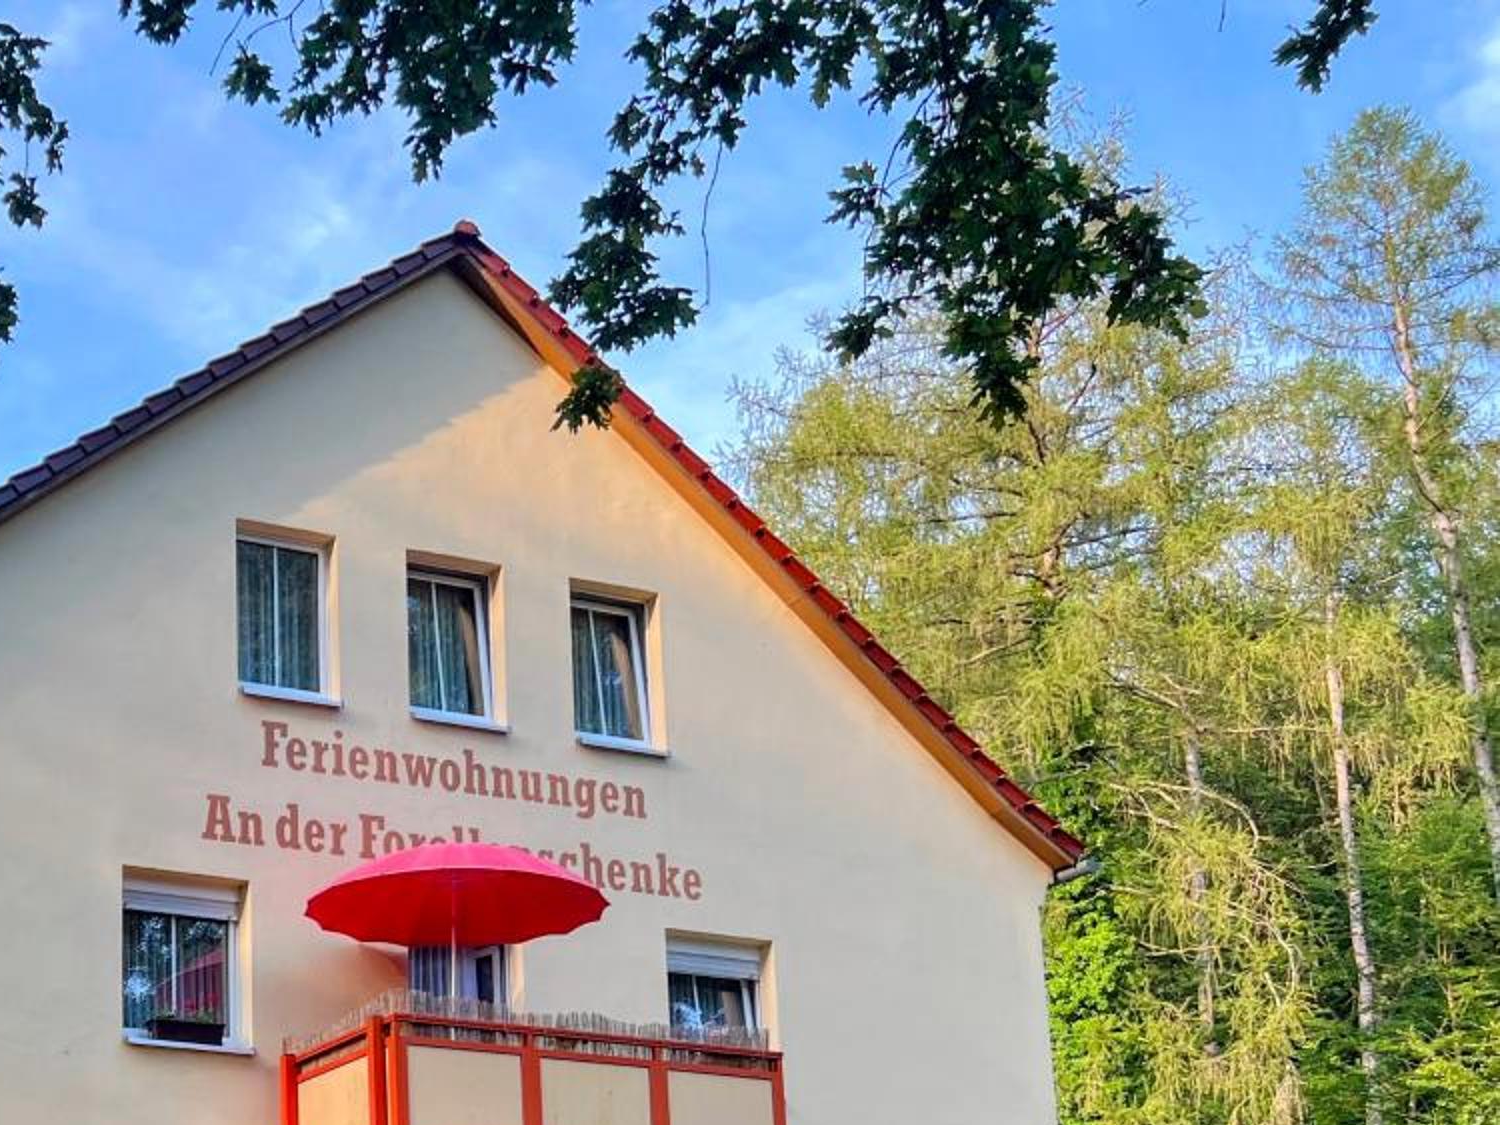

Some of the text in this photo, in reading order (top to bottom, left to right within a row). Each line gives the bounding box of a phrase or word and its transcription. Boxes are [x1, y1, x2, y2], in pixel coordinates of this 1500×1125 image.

[261, 719, 647, 819] Ferienwohnungen
[201, 793, 703, 901] An der Fochenke
